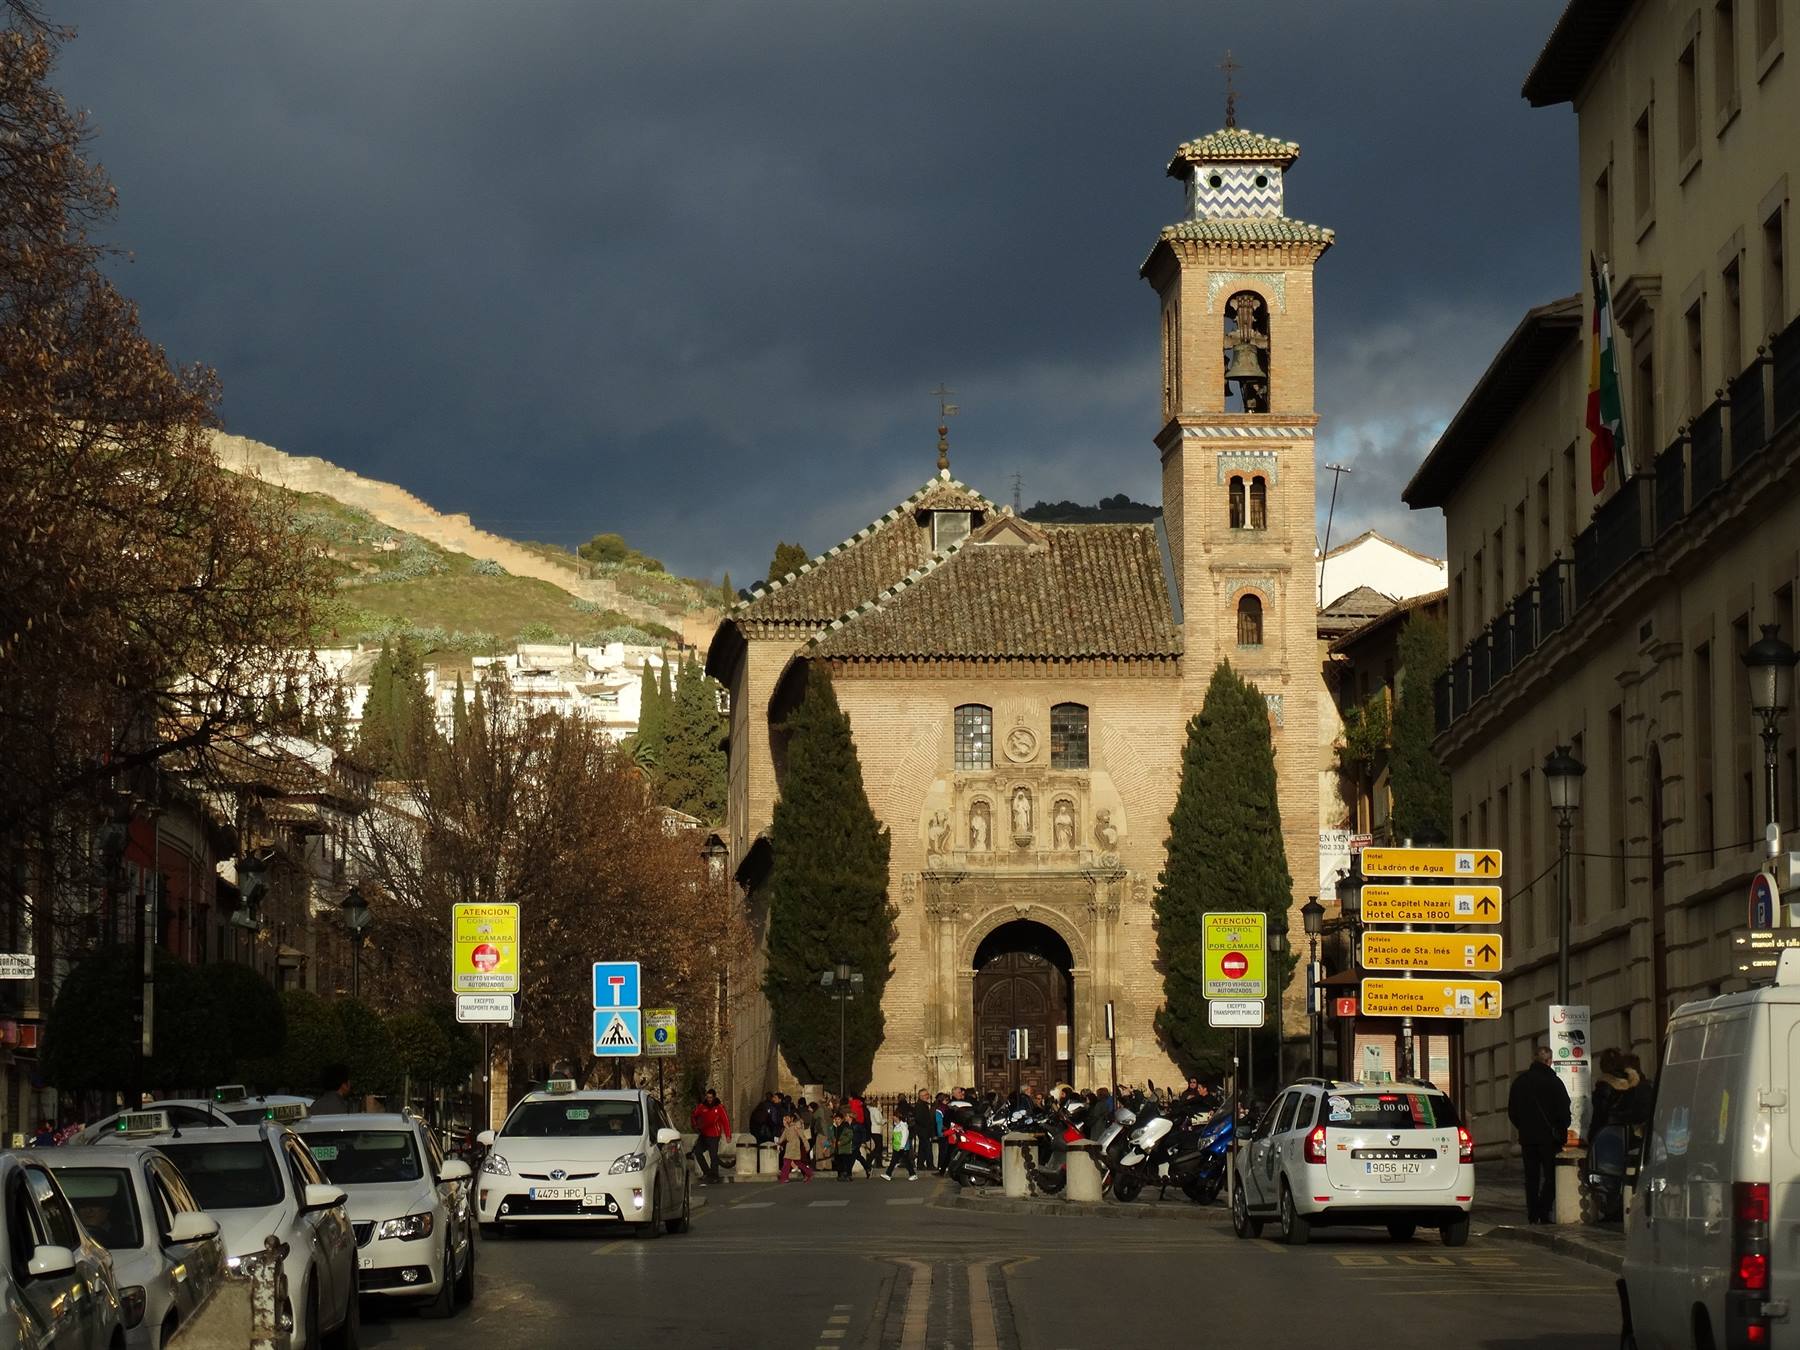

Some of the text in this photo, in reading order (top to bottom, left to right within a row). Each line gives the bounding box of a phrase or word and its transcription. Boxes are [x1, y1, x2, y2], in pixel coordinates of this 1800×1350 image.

[1319, 834, 1330, 842] EN
[1390, 900, 1421, 908] Capitel
[1366, 910, 1450, 919] Hotel Casa 1800
[1776, 939, 1785, 947] de
[1412, 958, 1429, 966] Ana
[1367, 992, 1424, 1001] Casa Morisca
[1367, 1003, 1440, 1012] Zaguán del Darro
[1383, 1103, 1396, 1112] 00
[1397, 1103, 1410, 1112] 00
[1373, 1163, 1420, 1173] 9056 HZV
[537, 1189, 581, 1198] 4479 HPC
